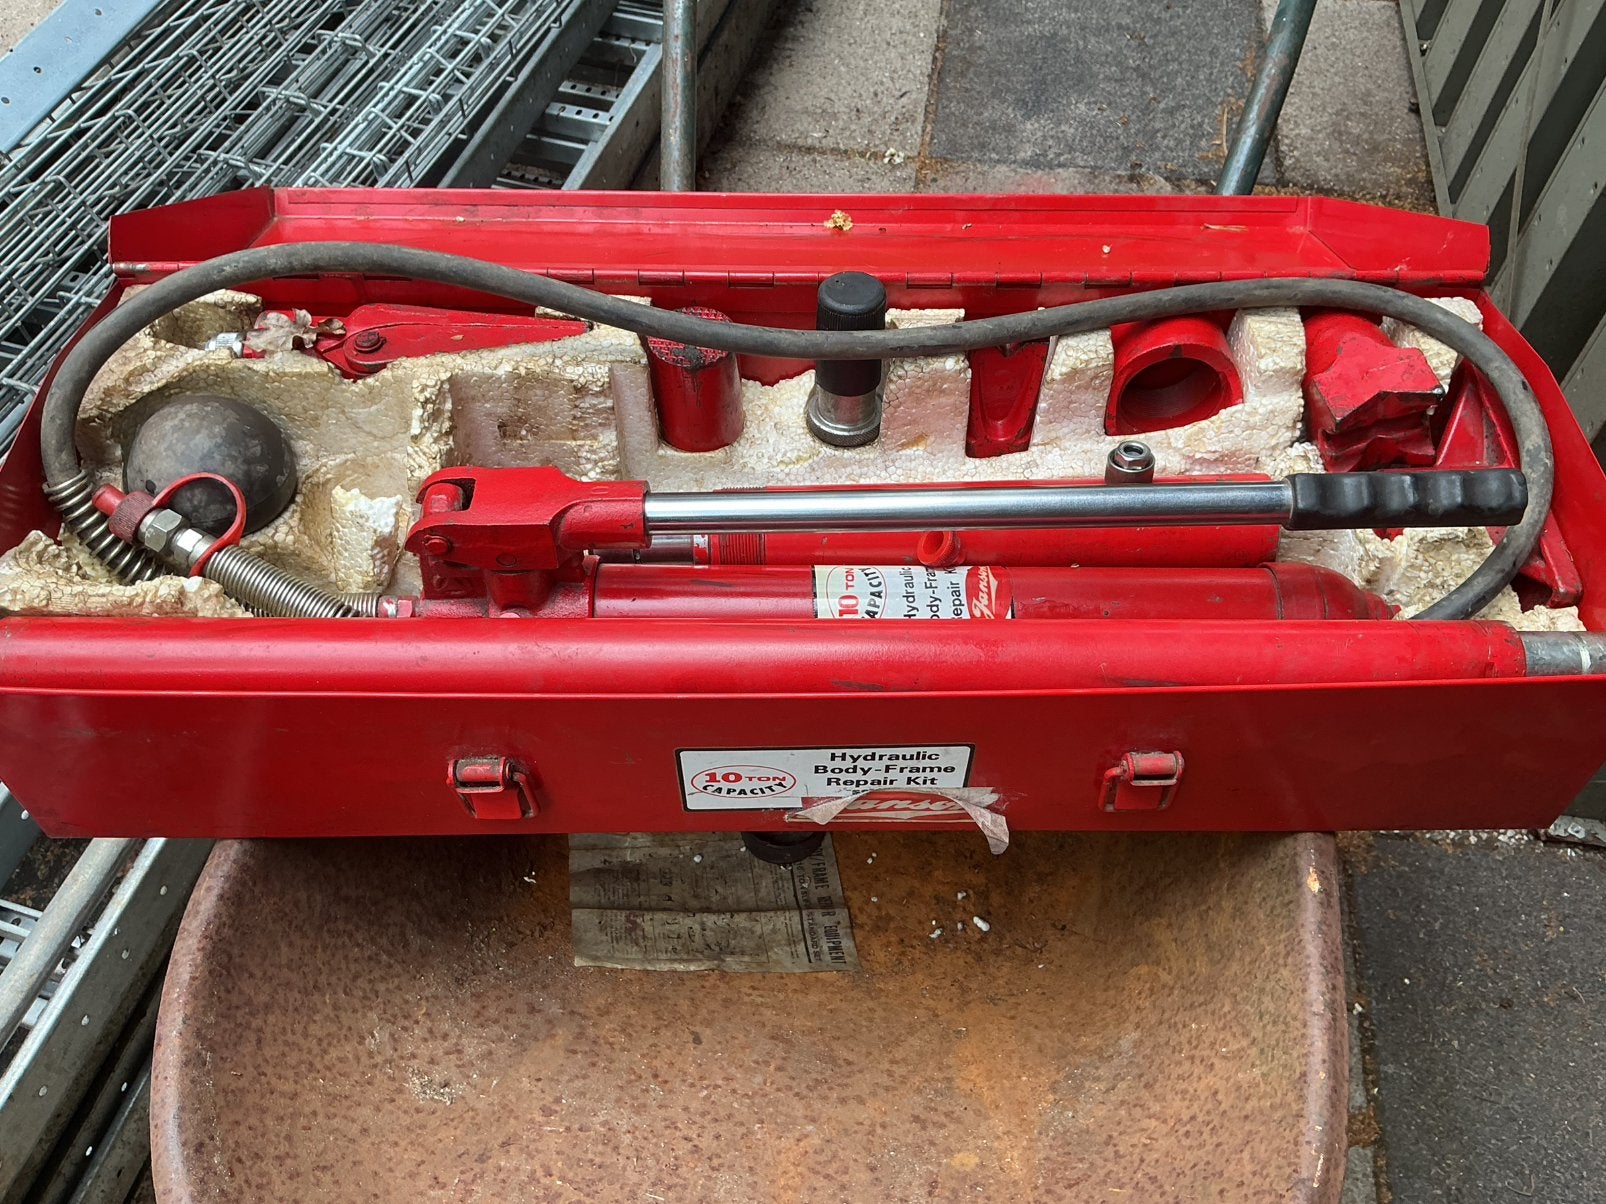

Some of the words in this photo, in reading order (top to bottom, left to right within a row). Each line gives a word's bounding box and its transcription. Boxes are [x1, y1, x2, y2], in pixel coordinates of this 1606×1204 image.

[845, 568, 855, 590] TON
[859, 567, 883, 618] APACITY
[924, 566, 942, 618] ody-Fra
[947, 581, 964, 618] epair
[838, 595, 859, 618] 10
[830, 751, 940, 763] Hydraulic
[705, 772, 743, 783] 10
[814, 764, 956, 776] Body-Frame
[702, 781, 787, 796] CAPACITY
[826, 776, 898, 788] Repair
[906, 776, 938, 786] Kit
[807, 911, 819, 949] STANDARD
[813, 950, 822, 961] SET
[824, 925, 847, 964] EQUIPMENT
